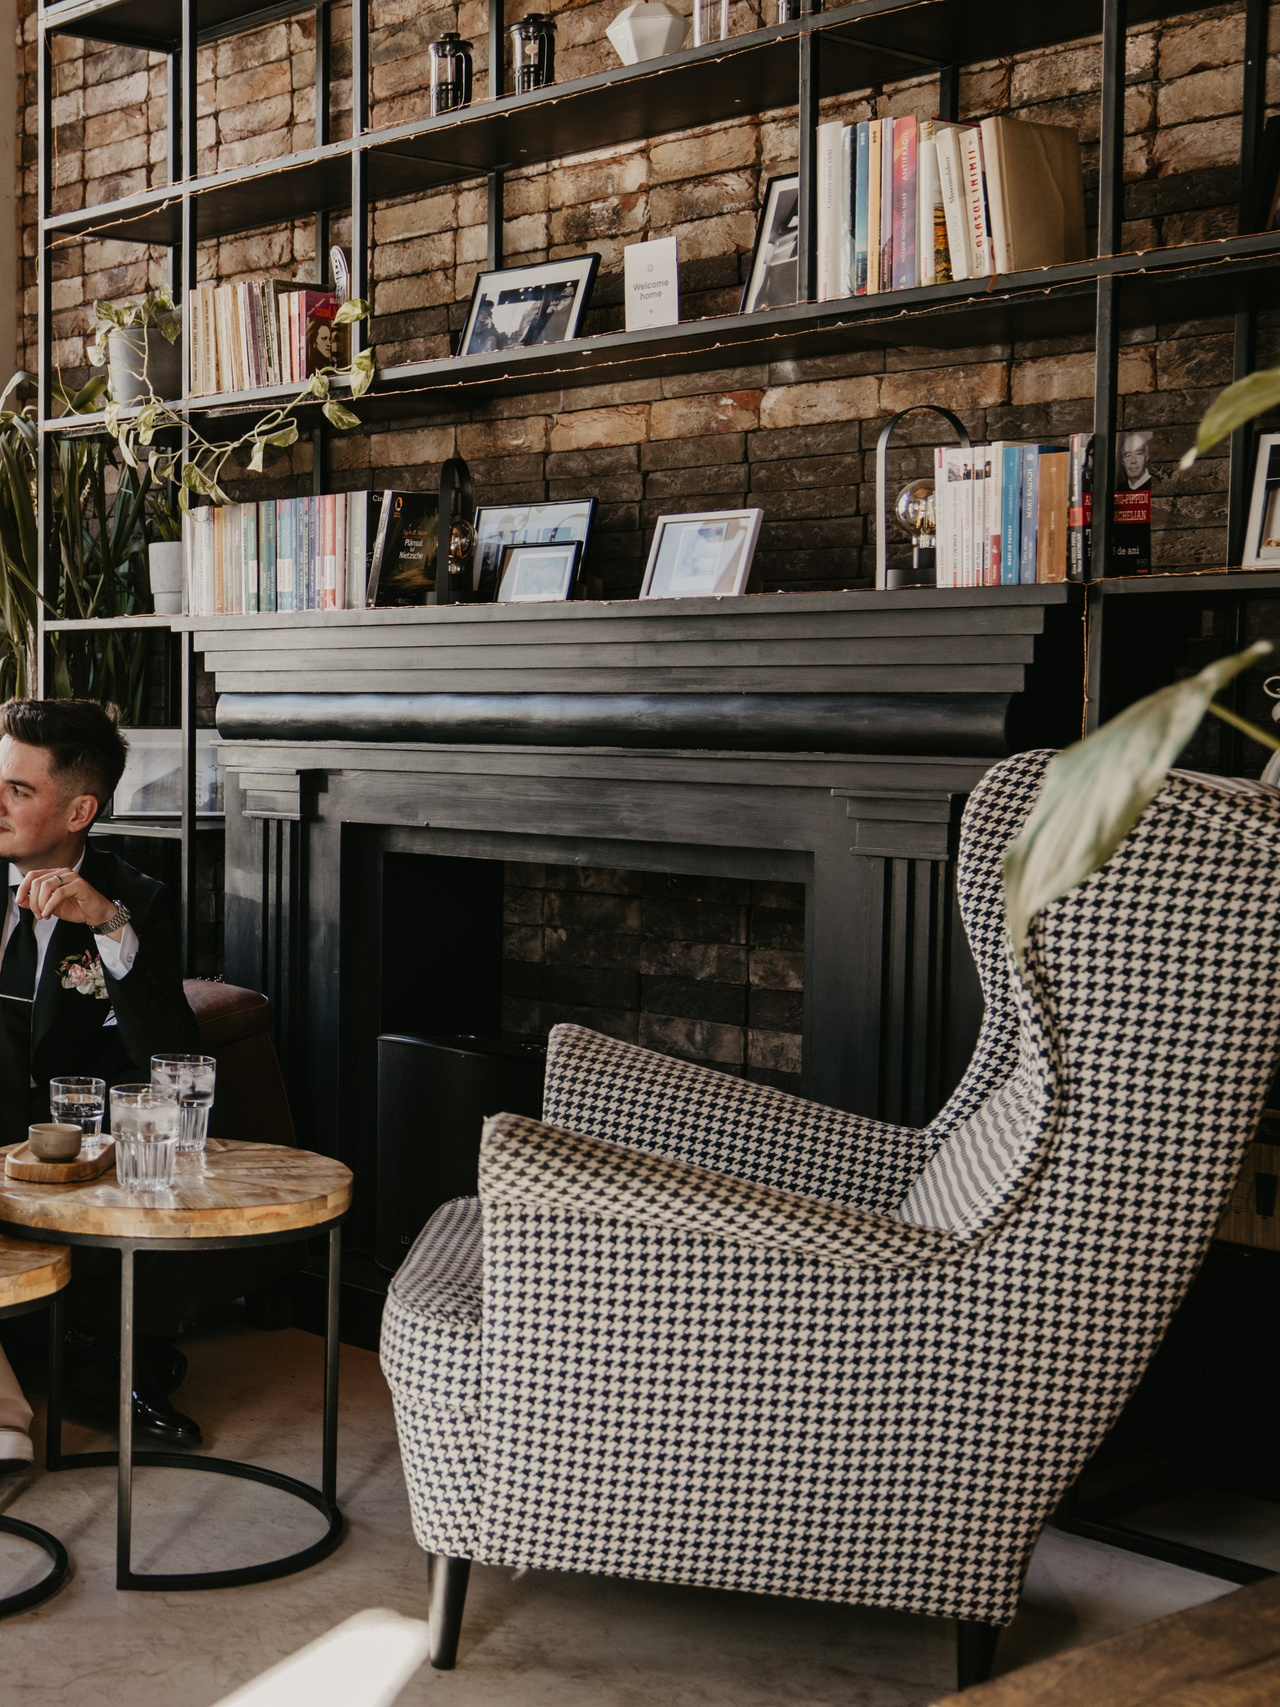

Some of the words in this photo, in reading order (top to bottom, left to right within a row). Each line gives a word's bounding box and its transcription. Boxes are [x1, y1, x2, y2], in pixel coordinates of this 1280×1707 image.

[901, 130, 909, 180] ANTIFRAGIL
[967, 149, 980, 193] INIMII
[972, 197, 983, 248] GLASUL
[633, 279, 669, 291] Welcome
[640, 291, 662, 300] home
[1114, 494, 1148, 505] GIU-PIPPIDI
[1114, 510, 1146, 521] ACHELIAN
[404, 539, 423, 547] Plânsul
[399, 551, 423, 560] Nietzsche
[1117, 547, 1125, 555] de
[1128, 546, 1139, 555] ani
